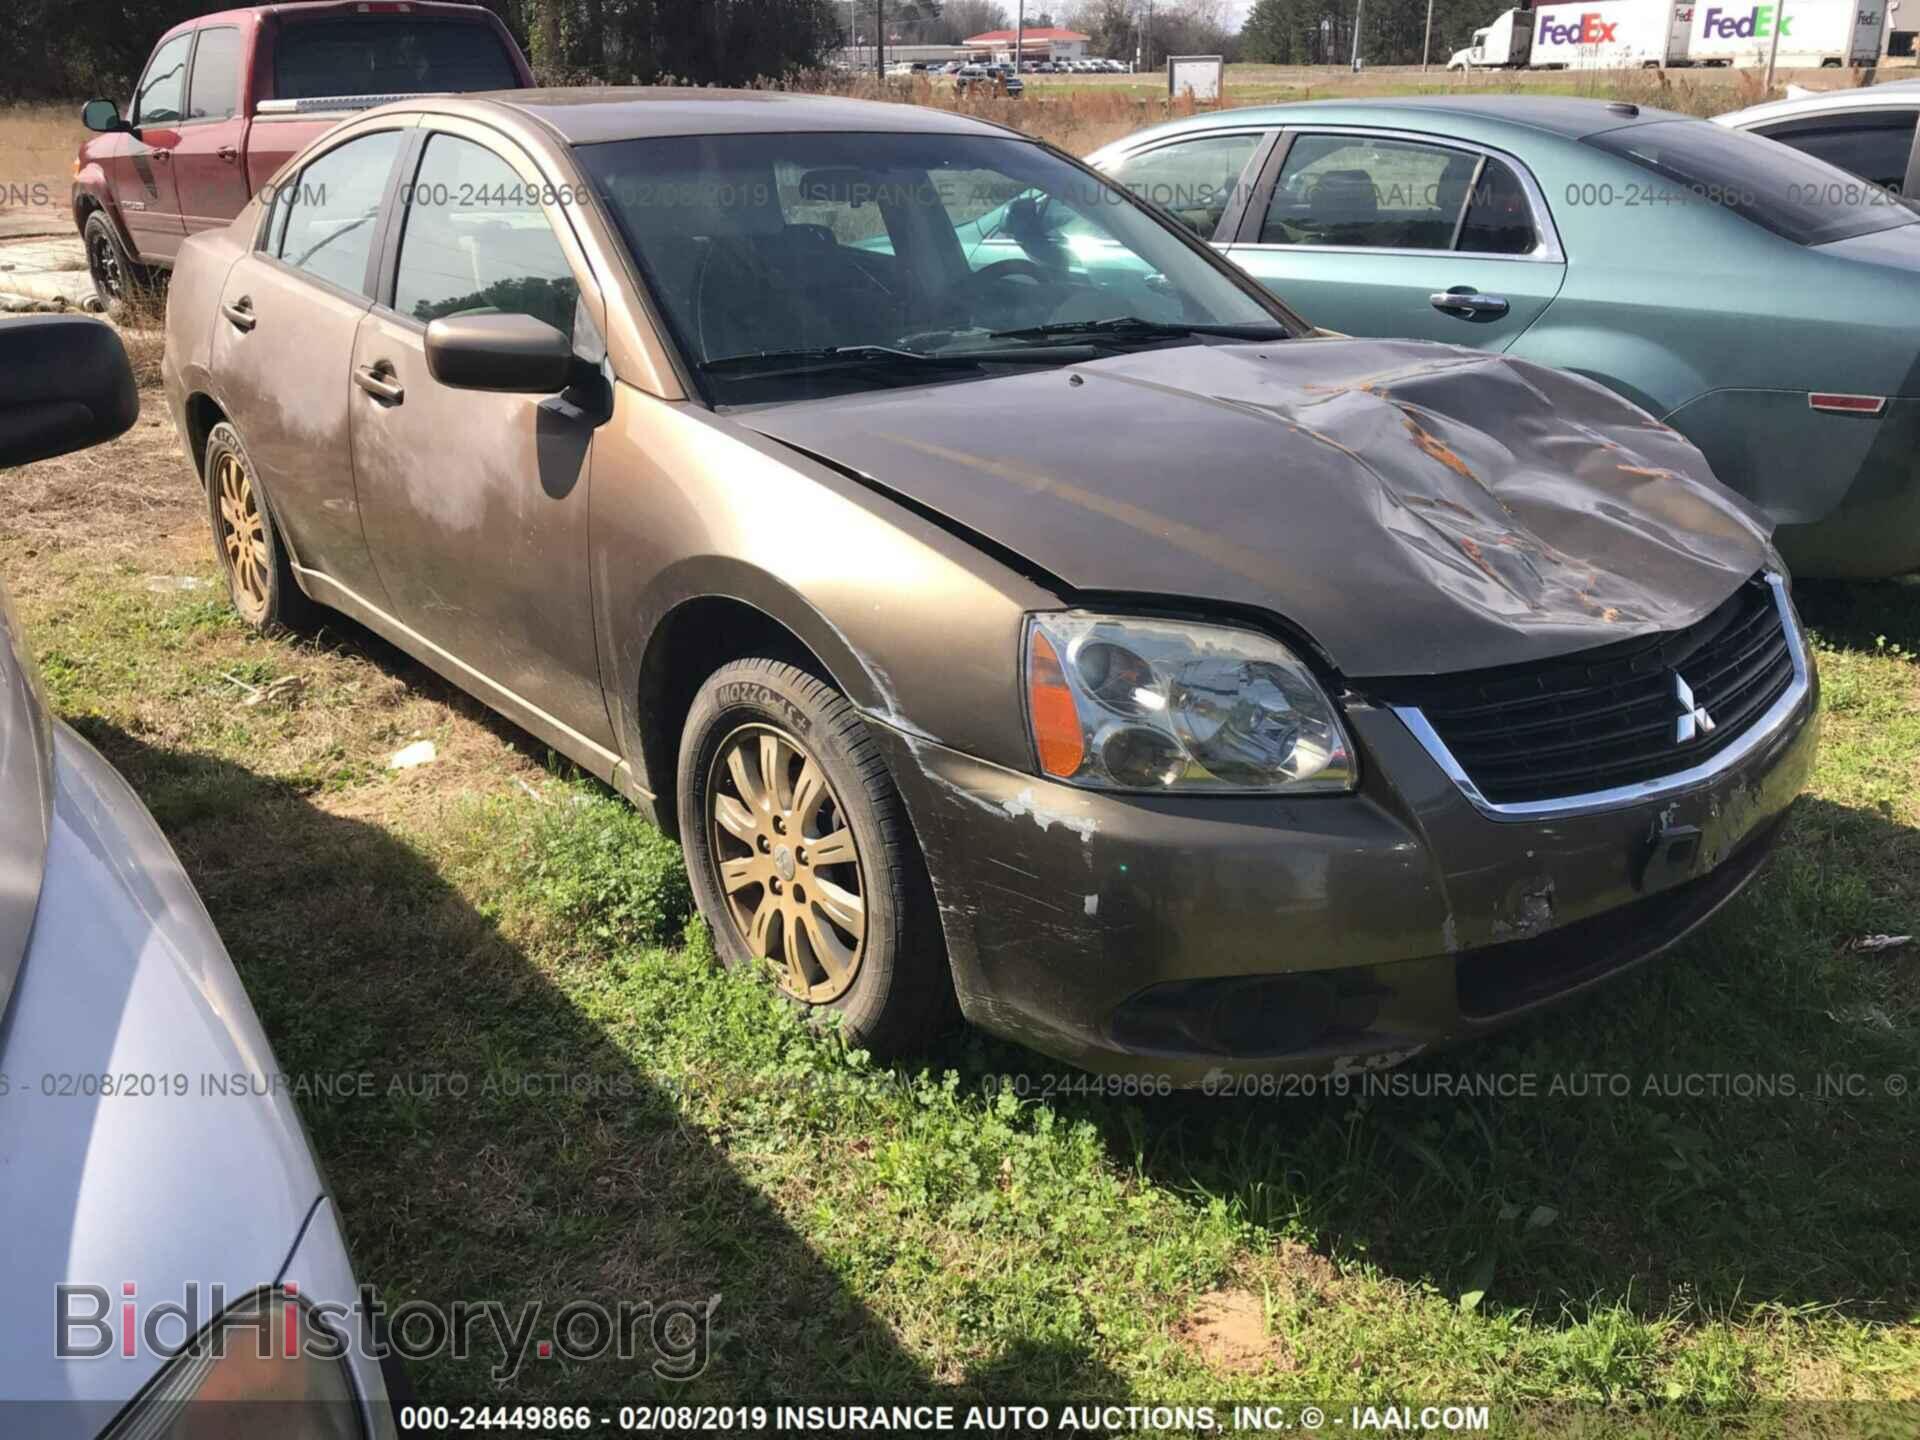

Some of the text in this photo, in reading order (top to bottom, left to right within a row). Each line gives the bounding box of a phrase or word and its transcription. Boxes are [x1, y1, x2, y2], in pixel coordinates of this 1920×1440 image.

[1674, 8, 1694, 22] FedE
[1703, 5, 1794, 38] FedEx
[1538, 13, 1617, 45] FedEx
[719, 683, 771, 705] MOZZO
